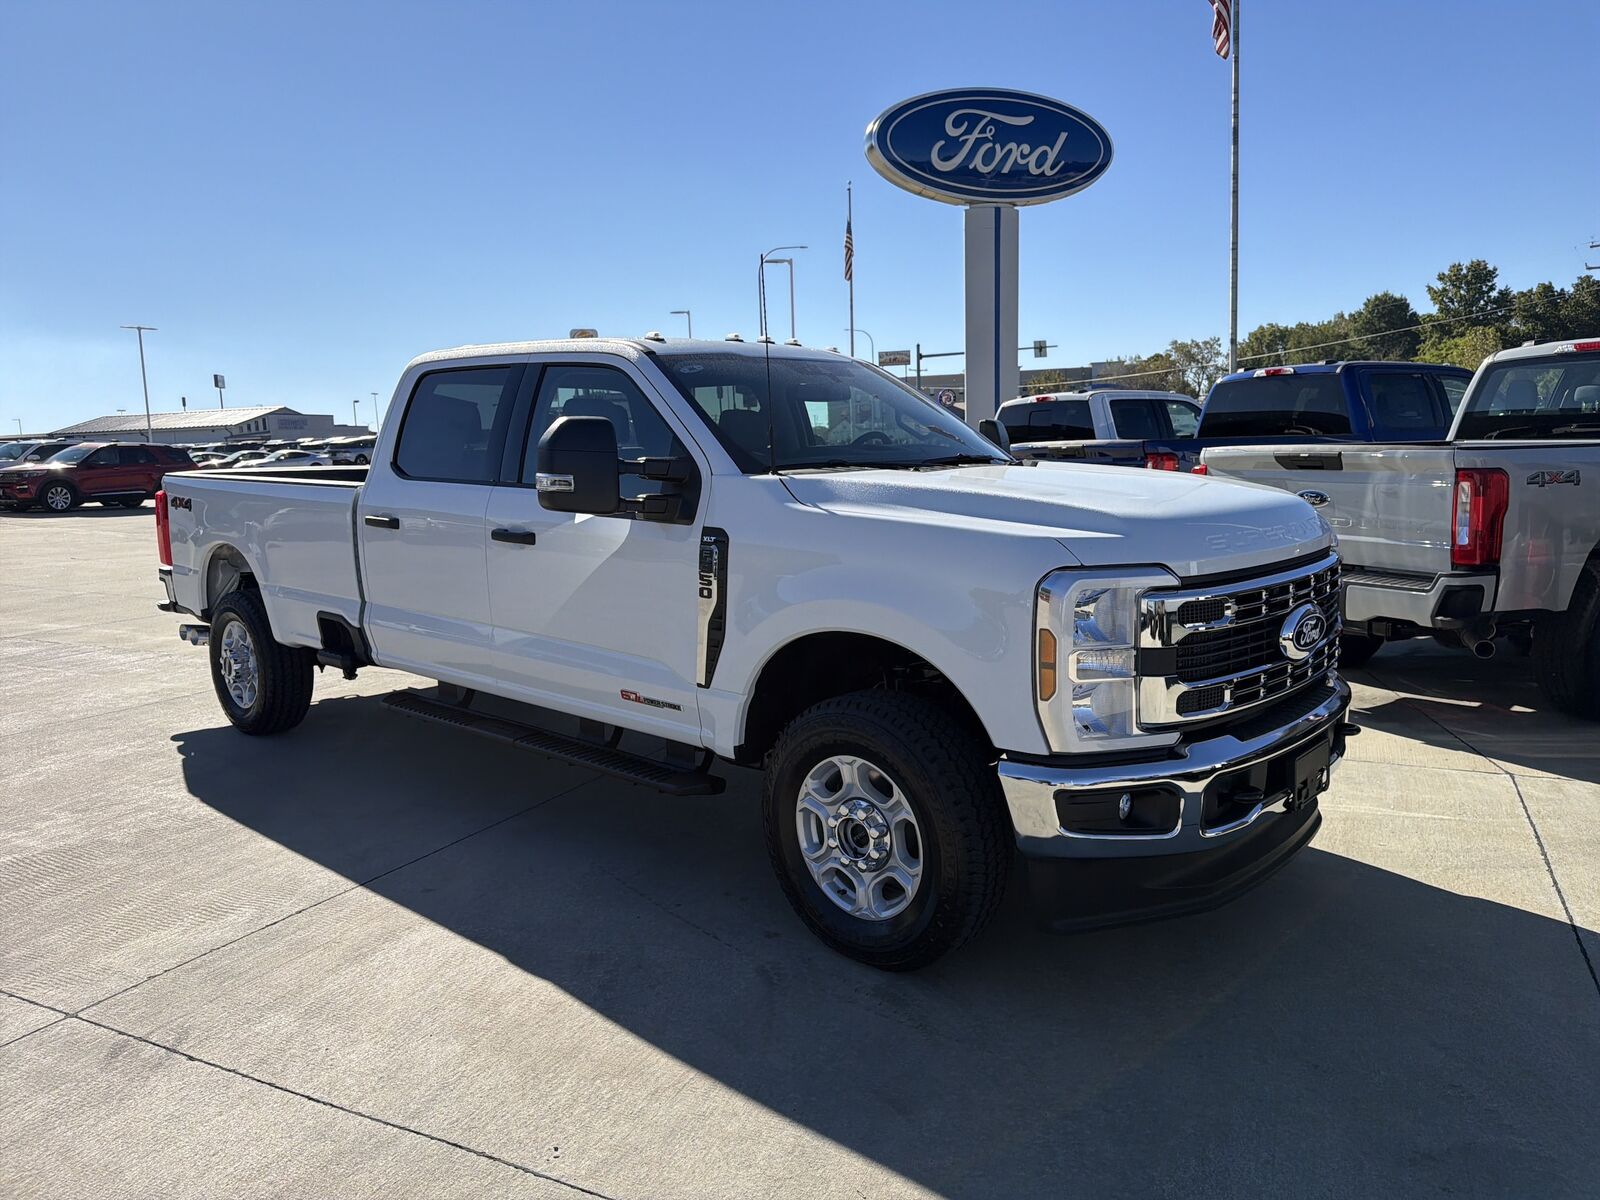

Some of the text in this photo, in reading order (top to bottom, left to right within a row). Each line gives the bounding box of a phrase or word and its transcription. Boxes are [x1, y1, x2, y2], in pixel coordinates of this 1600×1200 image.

[930, 108, 1069, 176] Ford
[1303, 492, 1321, 504] Ford
[1300, 618, 1322, 645] Ford
